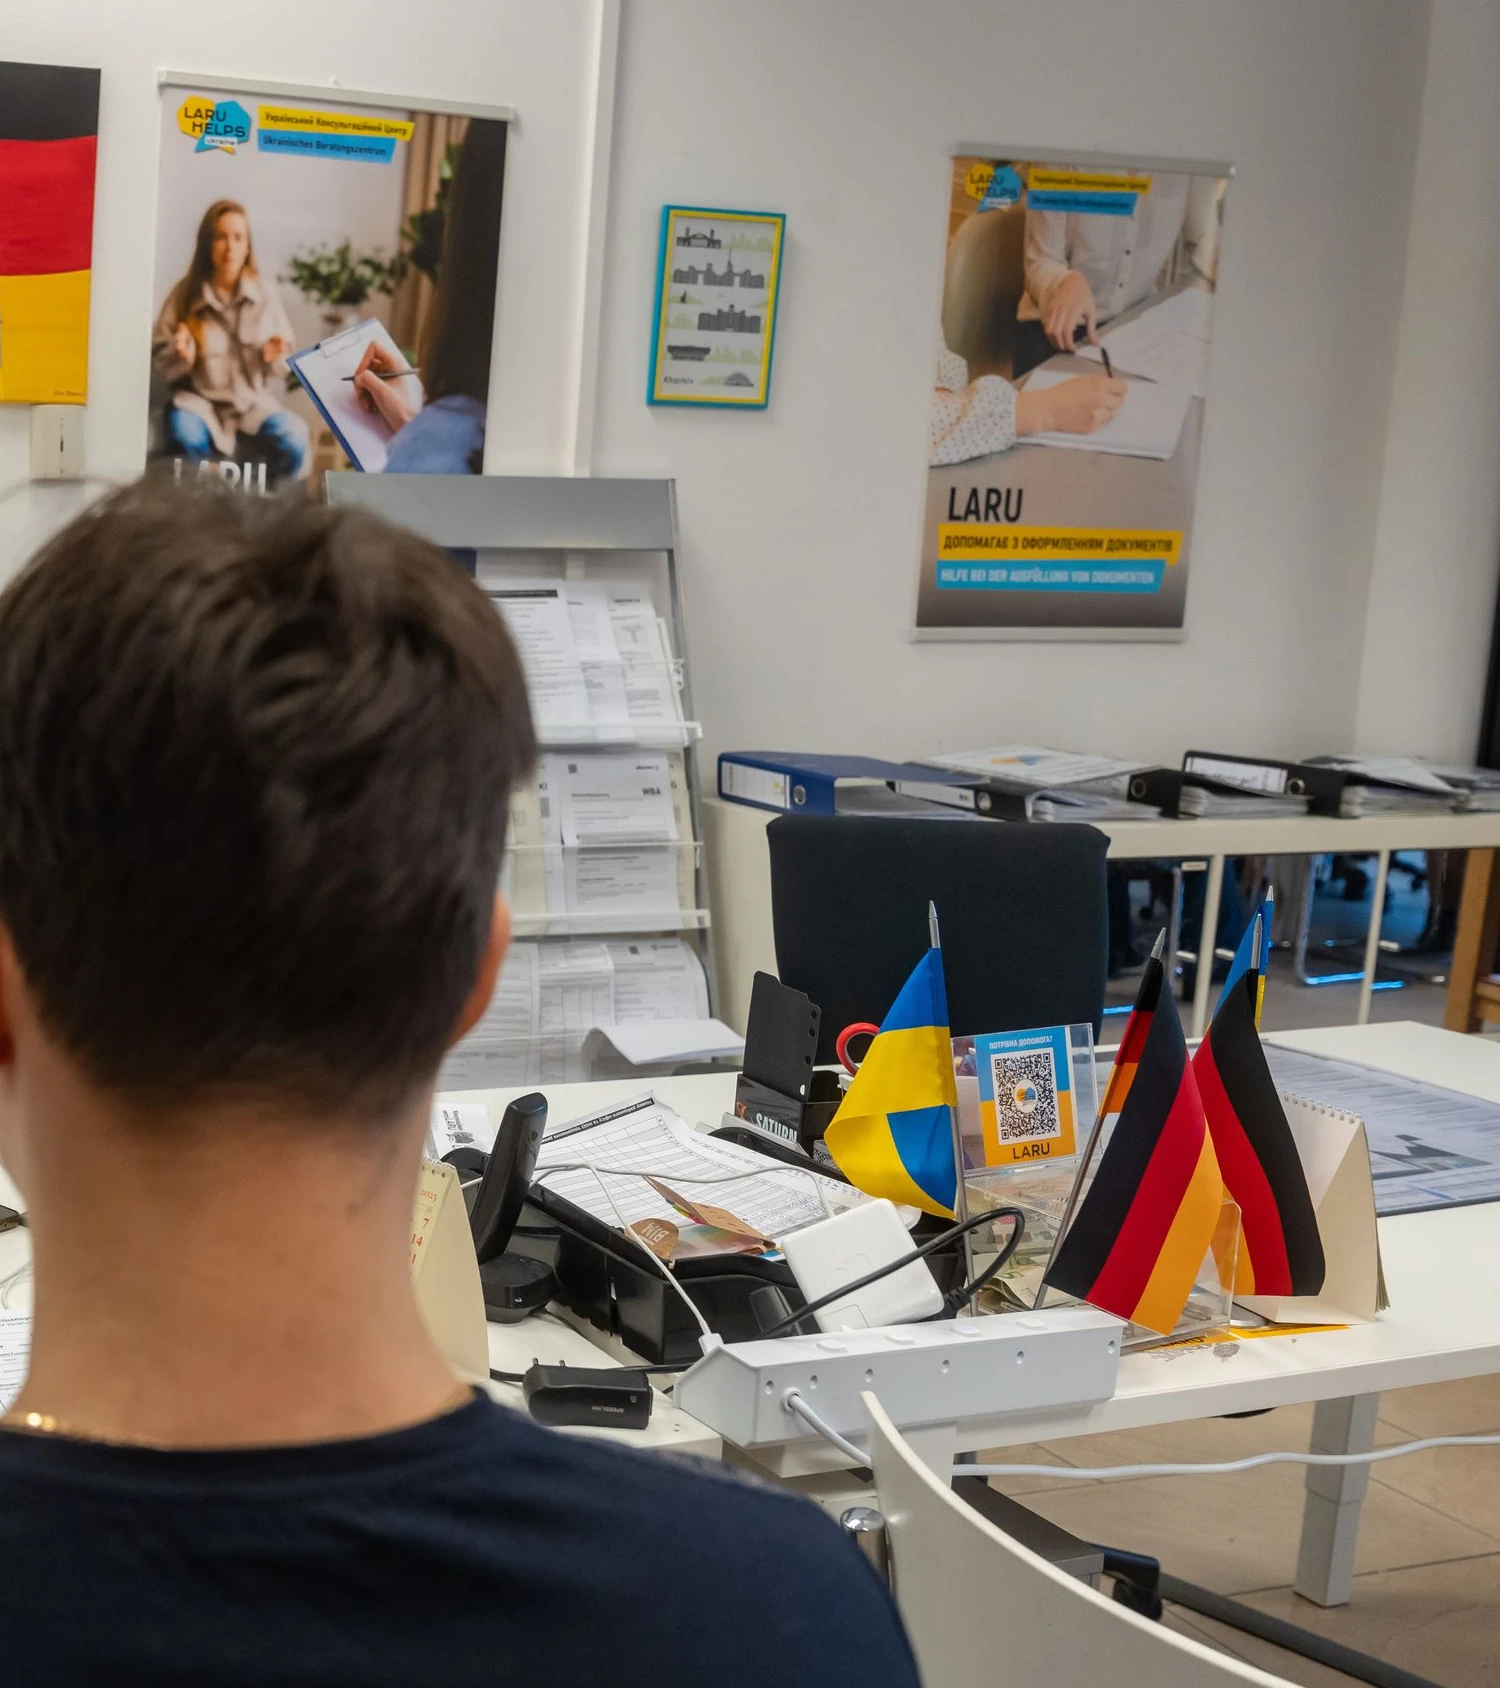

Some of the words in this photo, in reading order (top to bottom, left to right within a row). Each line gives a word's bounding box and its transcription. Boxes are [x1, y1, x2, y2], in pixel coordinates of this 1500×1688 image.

[184, 107, 227, 122] LARU
[192, 121, 246, 138] HELPS
[948, 487, 1023, 522] LARU
[944, 536, 1009, 549] ДОПОМАГАЄ
[940, 569, 968, 581] HILFE
[988, 570, 1007, 582] DER
[1012, 1142, 1050, 1160] LARU
[420, 1189, 438, 1203] 2025
[422, 1218, 429, 1229] 7
[411, 1233, 423, 1247] 14
